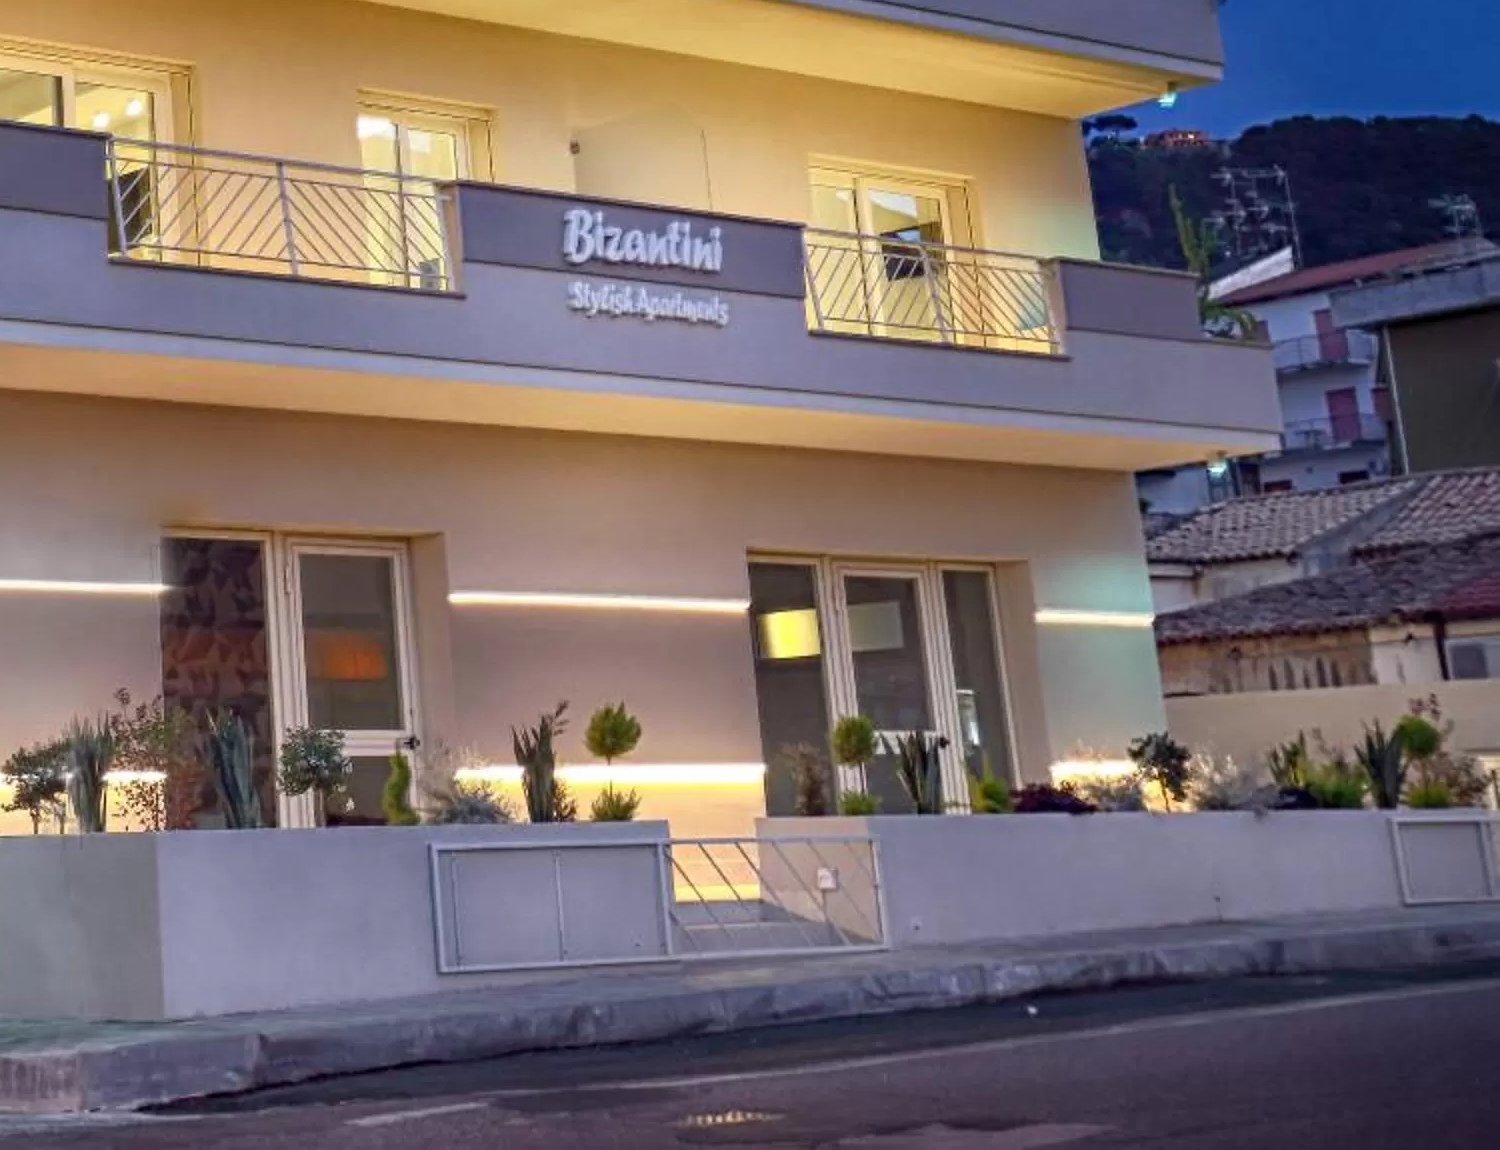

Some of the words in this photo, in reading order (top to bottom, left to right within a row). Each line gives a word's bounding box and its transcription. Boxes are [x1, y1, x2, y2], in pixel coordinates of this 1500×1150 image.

[564, 208, 722, 272] Bizantini
[569, 281, 634, 315] Stylish
[636, 286, 729, 326] Apartments
